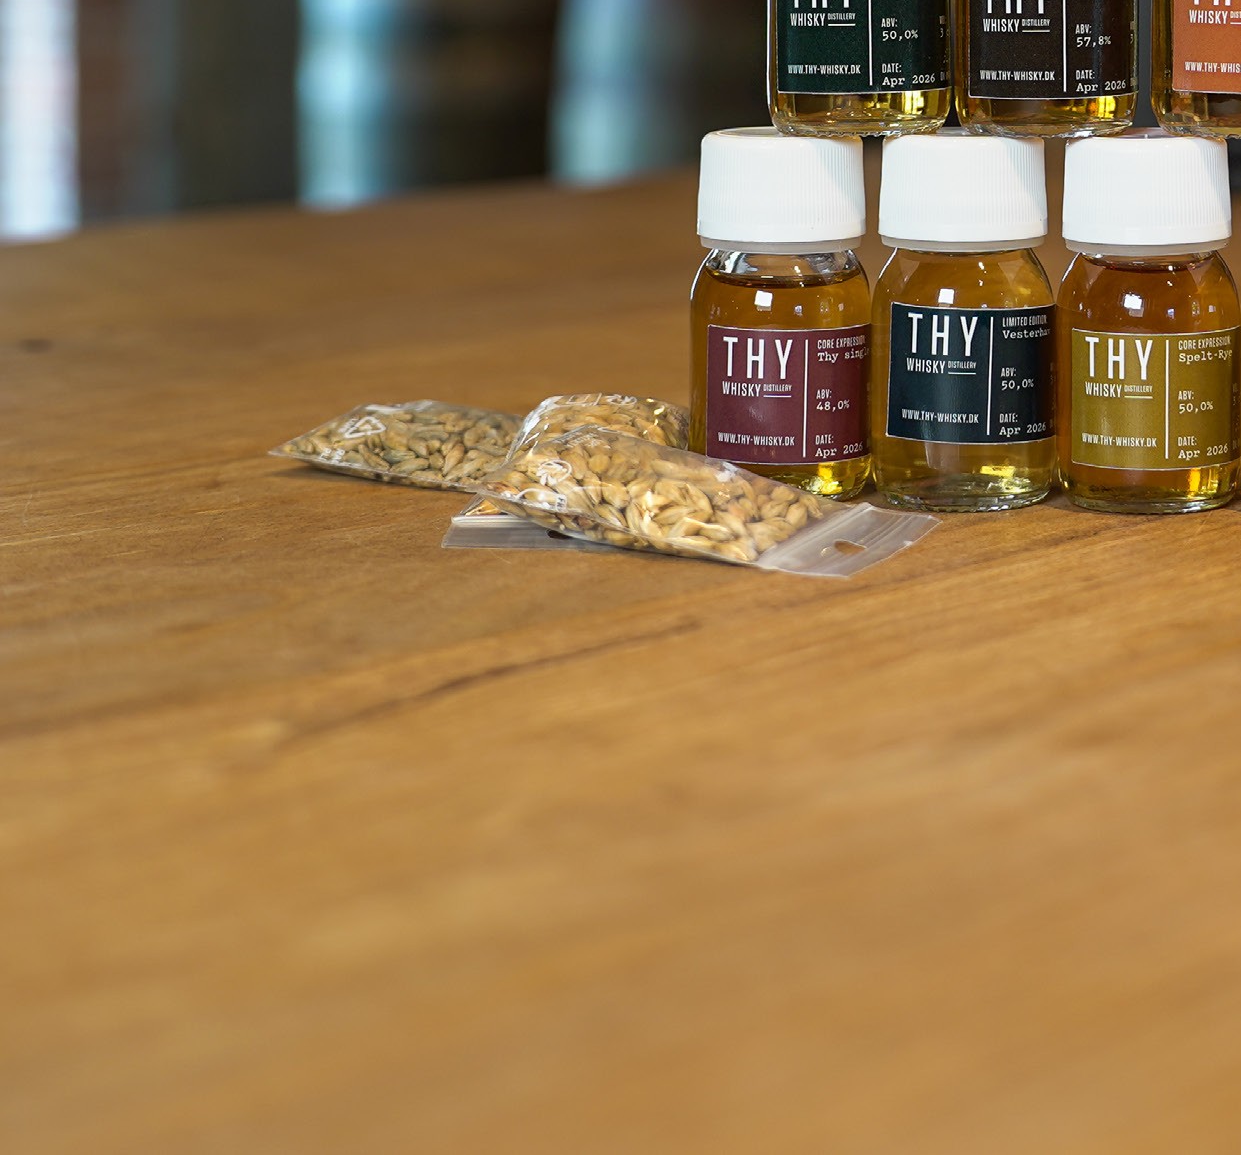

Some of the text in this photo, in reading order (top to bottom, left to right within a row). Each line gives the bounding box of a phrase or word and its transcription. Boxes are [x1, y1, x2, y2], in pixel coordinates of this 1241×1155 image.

[790, 13, 825, 27] WHISKY
[881, 18, 898, 28] ABV:
[1189, 10, 1228, 25] WHISKY
[983, 18, 1050, 33] WHISKY DISTILLERY
[1075, 24, 1092, 35] ABV:
[882, 30, 919, 42] 50,0%
[1076, 36, 1111, 48] 57,8%
[788, 64, 861, 75] WWW.THY-WHISKY.DK
[882, 63, 902, 74] DATE:
[882, 76, 905, 87] Apr
[912, 73, 935, 84] 2026
[980, 70, 1055, 81] WWW.THY-WHISKY.DK
[1075, 70, 1095, 80] DATE:
[1076, 83, 1099, 94] Apr
[1104, 80, 1127, 91] 2026
[1002, 316, 1028, 327] LIMITED
[908, 312, 979, 357] THY
[817, 339, 834, 349] CORE
[1178, 340, 1196, 350] CORE
[723, 336, 793, 380] THY
[817, 351, 839, 363] Thy
[1085, 336, 1153, 380] THY
[1178, 349, 1233, 365] Spelt-Rye
[906, 357, 977, 374] WHISKY DISTILLERY
[1001, 368, 1017, 377] ABV:
[722, 381, 792, 397] WHISKY DISTILLERY
[1001, 378, 1034, 390] 50,0%
[1085, 381, 1153, 398] WHISKY DISTILLERY
[816, 389, 832, 399] ABV:
[1178, 391, 1195, 401] ABV:
[816, 400, 850, 412] 48,0%
[1178, 401, 1214, 414] 50,0%
[901, 408, 979, 424] WWW.THY-WHISKY.DK
[1000, 413, 1018, 423] DATE:
[999, 423, 1047, 437] Apr 2026
[718, 432, 795, 447] WWW.THY-WHISKY.DK
[815, 434, 834, 445] DATE:
[1081, 432, 1157, 448] WWW.THY-WHISKY.DK
[1178, 436, 1197, 446] DATE:
[815, 443, 864, 459] Apr 2026
[1178, 444, 1229, 461] Apr 2026
